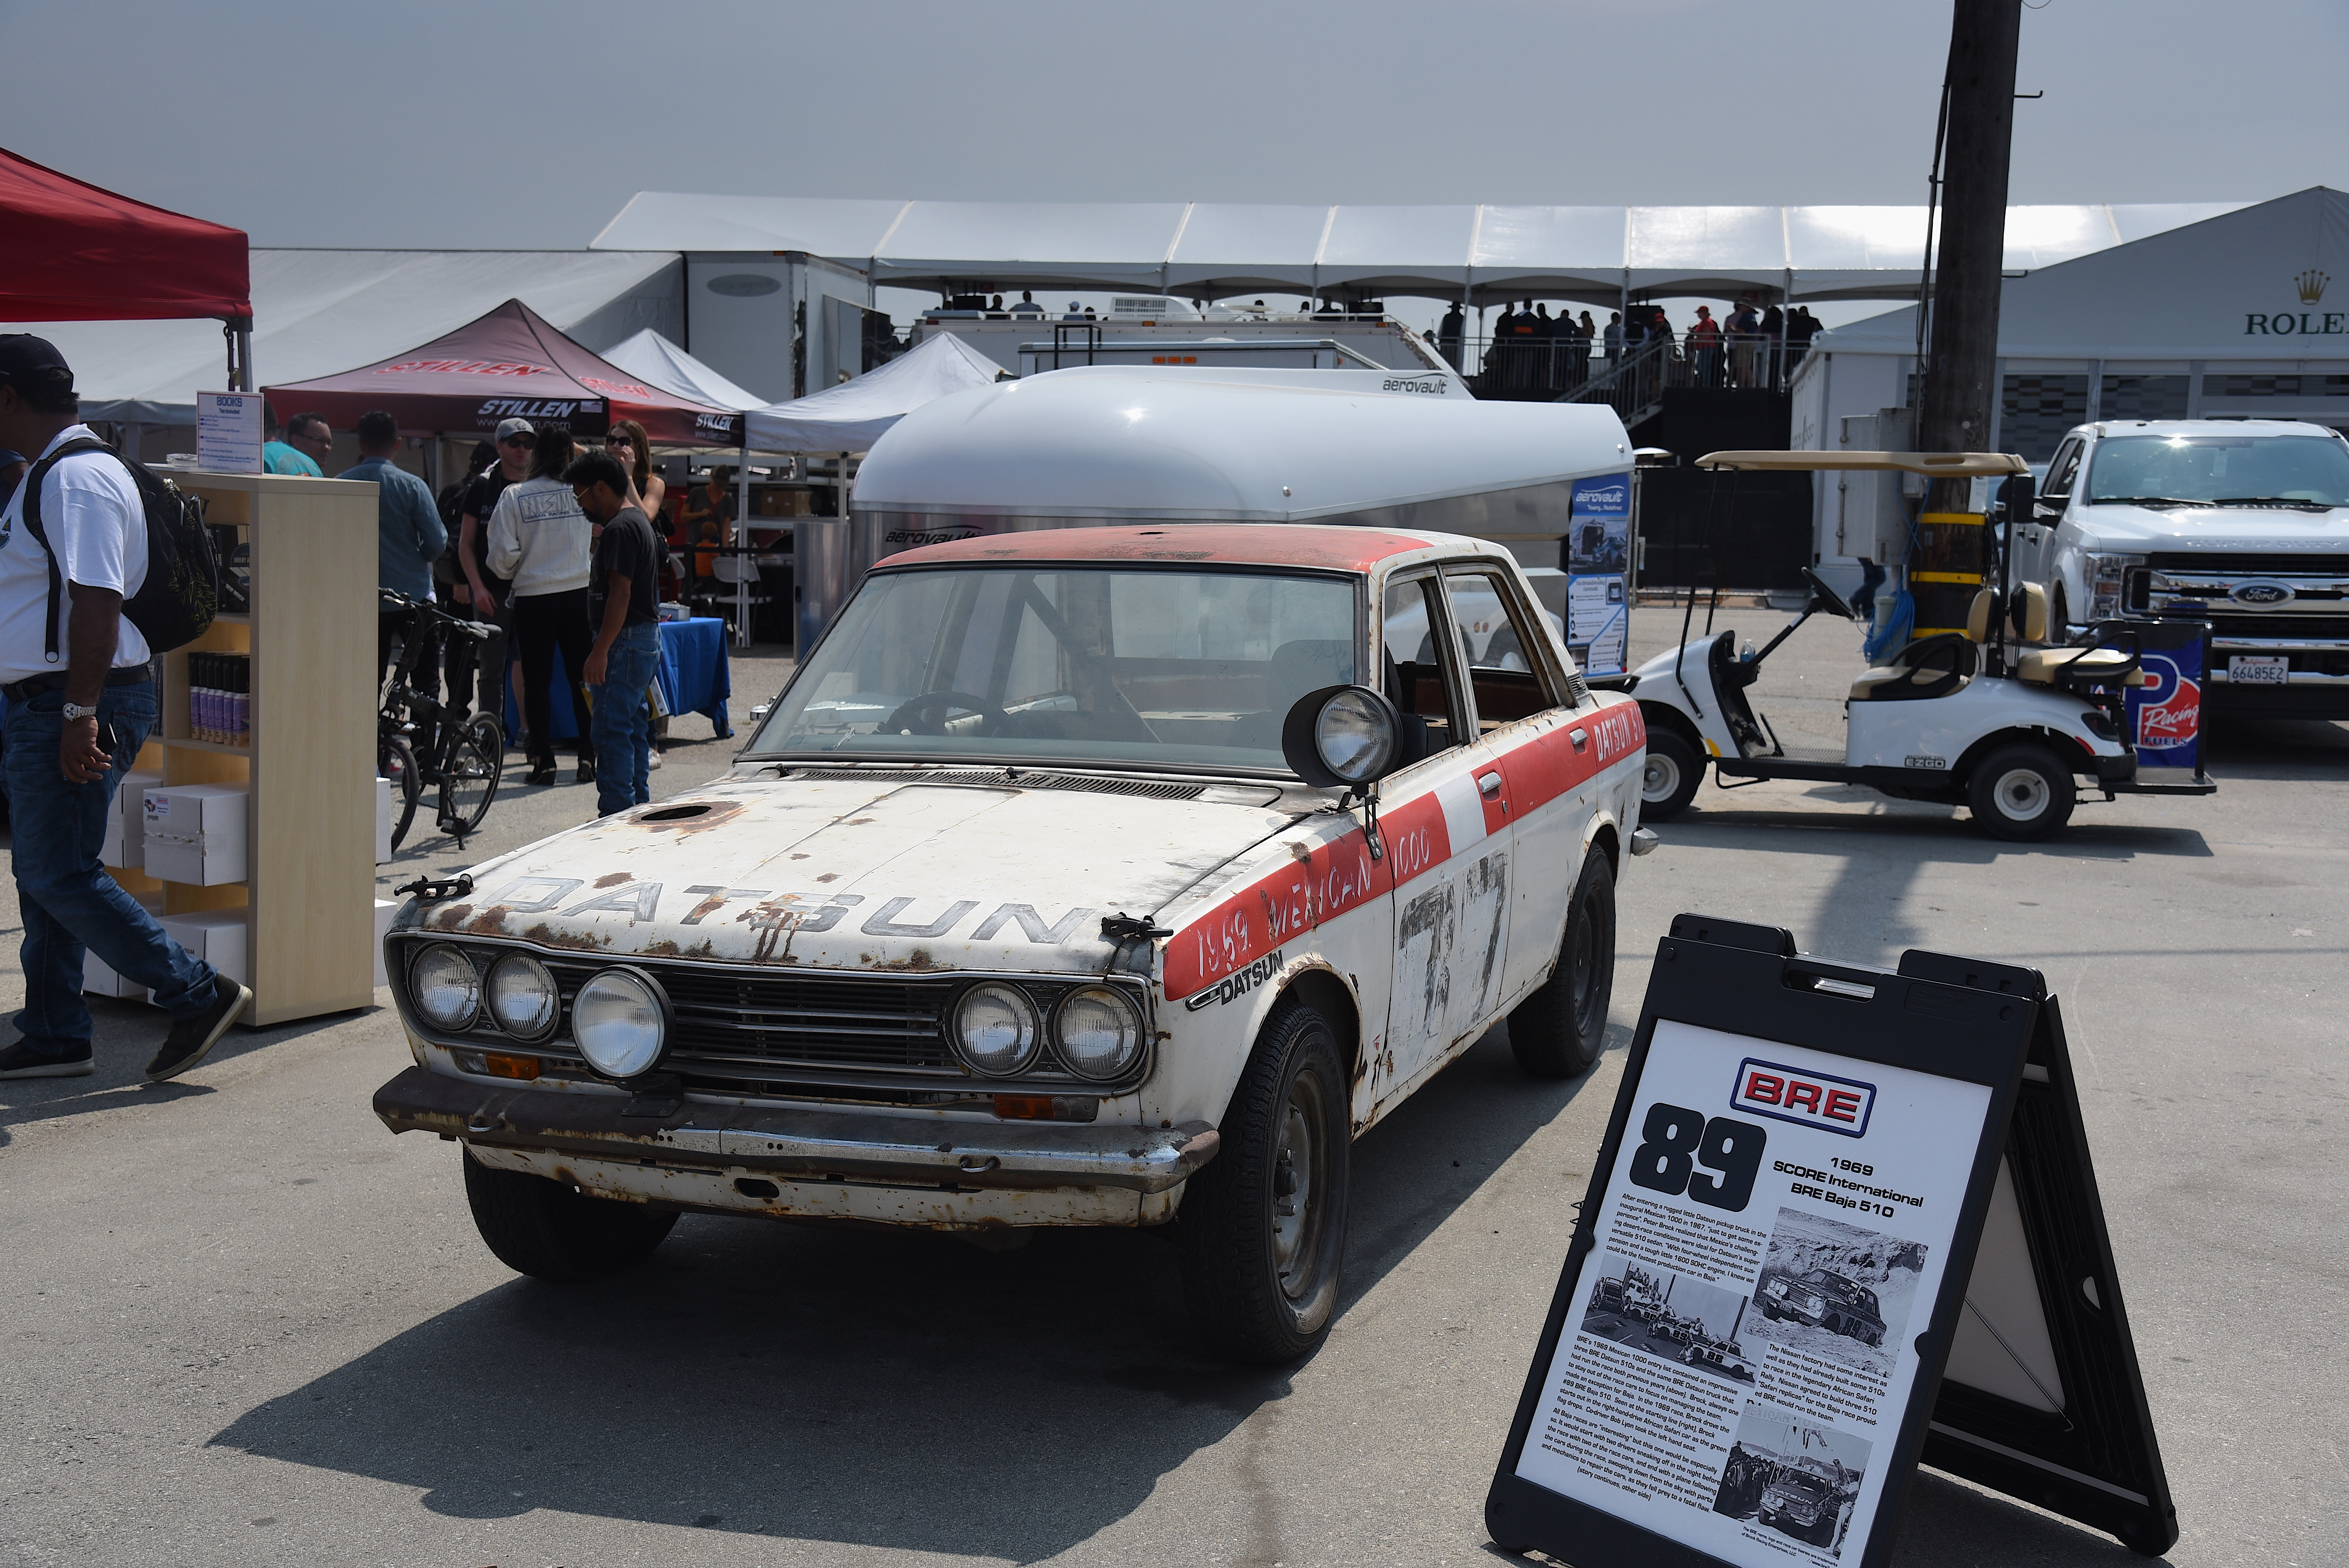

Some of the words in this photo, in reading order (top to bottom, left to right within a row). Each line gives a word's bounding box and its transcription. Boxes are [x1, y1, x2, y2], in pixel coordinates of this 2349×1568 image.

[2244, 314, 2349, 335] ROLE
[373, 360, 550, 377] STILLEN
[217, 396, 242, 407] BOOKS
[1383, 379, 1447, 394] aerovault
[477, 399, 577, 418] STILLEN
[695, 414, 734, 431] STILLEN
[1576, 490, 1623, 502] aerovault
[2187, 540, 2271, 548] SUPER
[2246, 587, 2279, 600] Ford
[2232, 666, 2284, 680] 66485E2
[1593, 711, 1631, 762] DATSUN
[2144, 705, 2199, 735] Racing
[2144, 736, 2187, 747] FUELS
[474, 875, 1098, 945] DATSUN
[1197, 909, 1249, 978] 1969
[1268, 854, 1371, 942] MEXICAN
[1393, 825, 1430, 880] 1000
[1220, 950, 1286, 1006] DATSUN
[1744, 1072, 1861, 1123] BRE
[1629, 1103, 1767, 1212] 89
[1830, 1157, 1873, 1176] 1969
[1772, 1160, 1827, 1183] SCORE
[1828, 1174, 1924, 1207] International
[1790, 1182, 1824, 1200] BRE
[1824, 1190, 1857, 1209] Baja
[1859, 1199, 1894, 1218] 510
[1621, 1192, 1636, 1201] After
[1636, 1198, 1658, 1209] entering
[1663, 1205, 1683, 1215] rugged
[1682, 1209, 1695, 1218] little
[1695, 1213, 1716, 1224] Datsun
[1715, 1219, 1734, 1230] pickup
[1734, 1224, 1750, 1234] truck
[1613, 1217, 1622, 1227] ing
[1622, 1221, 1653, 1234] desert-race
[1653, 1231, 1680, 1242] conditions
[1681, 1238, 1695, 1247] were
[1695, 1241, 1709, 1251] ideal
[1718, 1248, 1743, 1261] Datsun's
[1743, 1257, 1760, 1265] super
[1673, 1329, 1688, 1340] 89
[1841, 1317, 1862, 1336] 89
[1574, 1343, 1588, 1353] three
[1588, 1348, 1600, 1358] BRE
[1600, 1352, 1620, 1365] Datsun
[1620, 1359, 1635, 1370] 510s
[1656, 1373, 1672, 1383] same
[1672, 1377, 1685, 1387] BRE
[1684, 1381, 1705, 1394] Datsun
[1706, 1390, 1721, 1400] truck
[1722, 1395, 1735, 1404] that
[1576, 1335, 1592, 1345] BRE's
[1593, 1340, 1608, 1350] 1969
[1608, 1345, 1631, 1358] Mexican
[1632, 1353, 1647, 1364] 1000
[1647, 1360, 1663, 1370] entry
[1662, 1364, 1672, 1372] list
[1672, 1369, 1700, 1382] contained
[1707, 1379, 1738, 1395] impressive
[1706, 1351, 1725, 1364] 88
[1769, 1343, 1779, 1352] The
[1780, 1347, 1801, 1359] Nissan
[1801, 1354, 1824, 1368] factory
[1823, 1361, 1836, 1370] had
[1836, 1367, 1853, 1376] some
[1854, 1370, 1879, 1384] interest
[1766, 1353, 1778, 1362] well
[1786, 1360, 1800, 1370] they
[1800, 1363, 1812, 1373] had
[1812, 1368, 1835, 1382] already
[1835, 1375, 1850, 1385] built
[1850, 1381, 1867, 1391] some
[1868, 1385, 1885, 1397] 510s
[1770, 1365, 1784, 1374] race
[1784, 1368, 1791, 1376] in
[1791, 1371, 1802, 1380] the
[1802, 1374, 1832, 1391] legendary
[1832, 1384, 1855, 1398] African
[1855, 1392, 1875, 1404] Safari
[1760, 1371, 1775, 1383] Rally.
[1778, 1377, 1799, 1390] Nissan
[1799, 1385, 1821, 1397] agreed
[1829, 1393, 1845, 1404] build
[1845, 1400, 1862, 1410] three
[1862, 1405, 1877, 1415] 510
[1577, 1465, 1594, 1478] (story
[1593, 1474, 1620, 1489] continues,
[1621, 1484, 1637, 1494] other
[1637, 1490, 1651, 1501] side)
[1770, 1486, 1813, 1505] DATSUN
